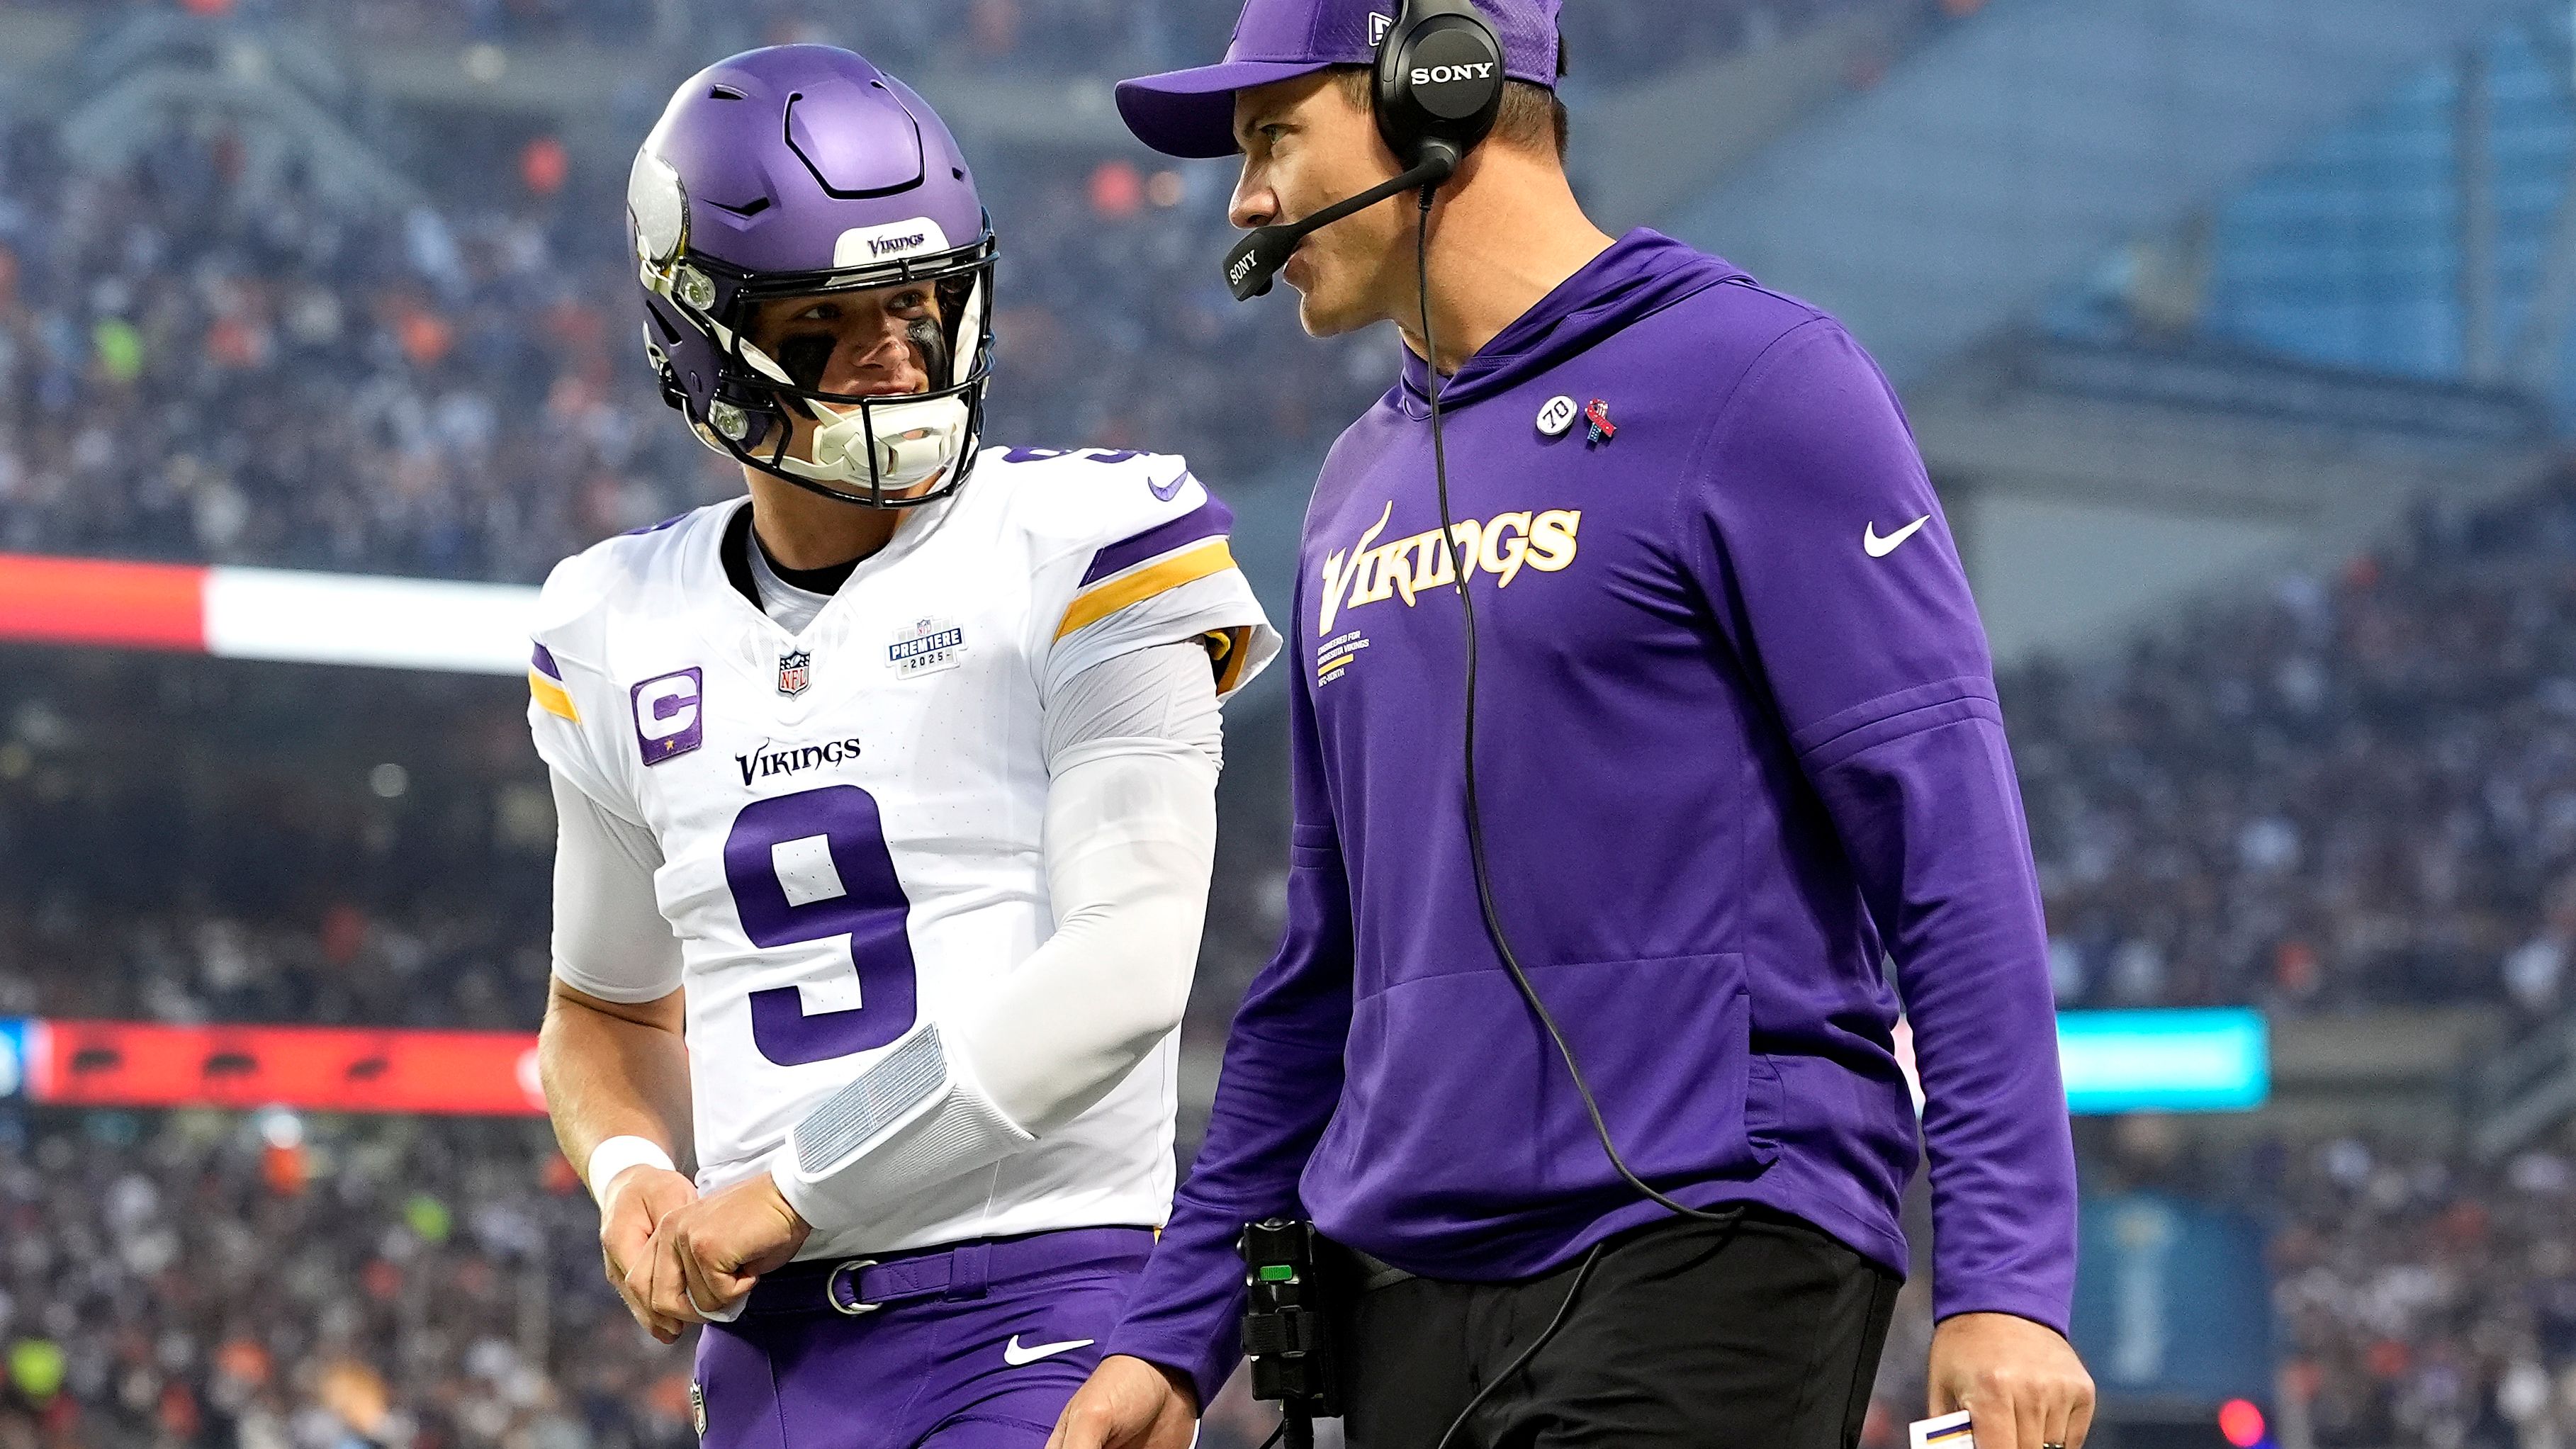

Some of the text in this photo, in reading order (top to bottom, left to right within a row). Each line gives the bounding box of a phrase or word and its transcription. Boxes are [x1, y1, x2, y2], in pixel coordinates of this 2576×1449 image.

[1410, 62, 1493, 84] SONY
[1230, 249, 1256, 285] SONY
[1543, 400, 1568, 428] 70
[781, 669, 807, 690] NFL
[636, 675, 697, 741] C
[724, 784, 917, 1066] 9
